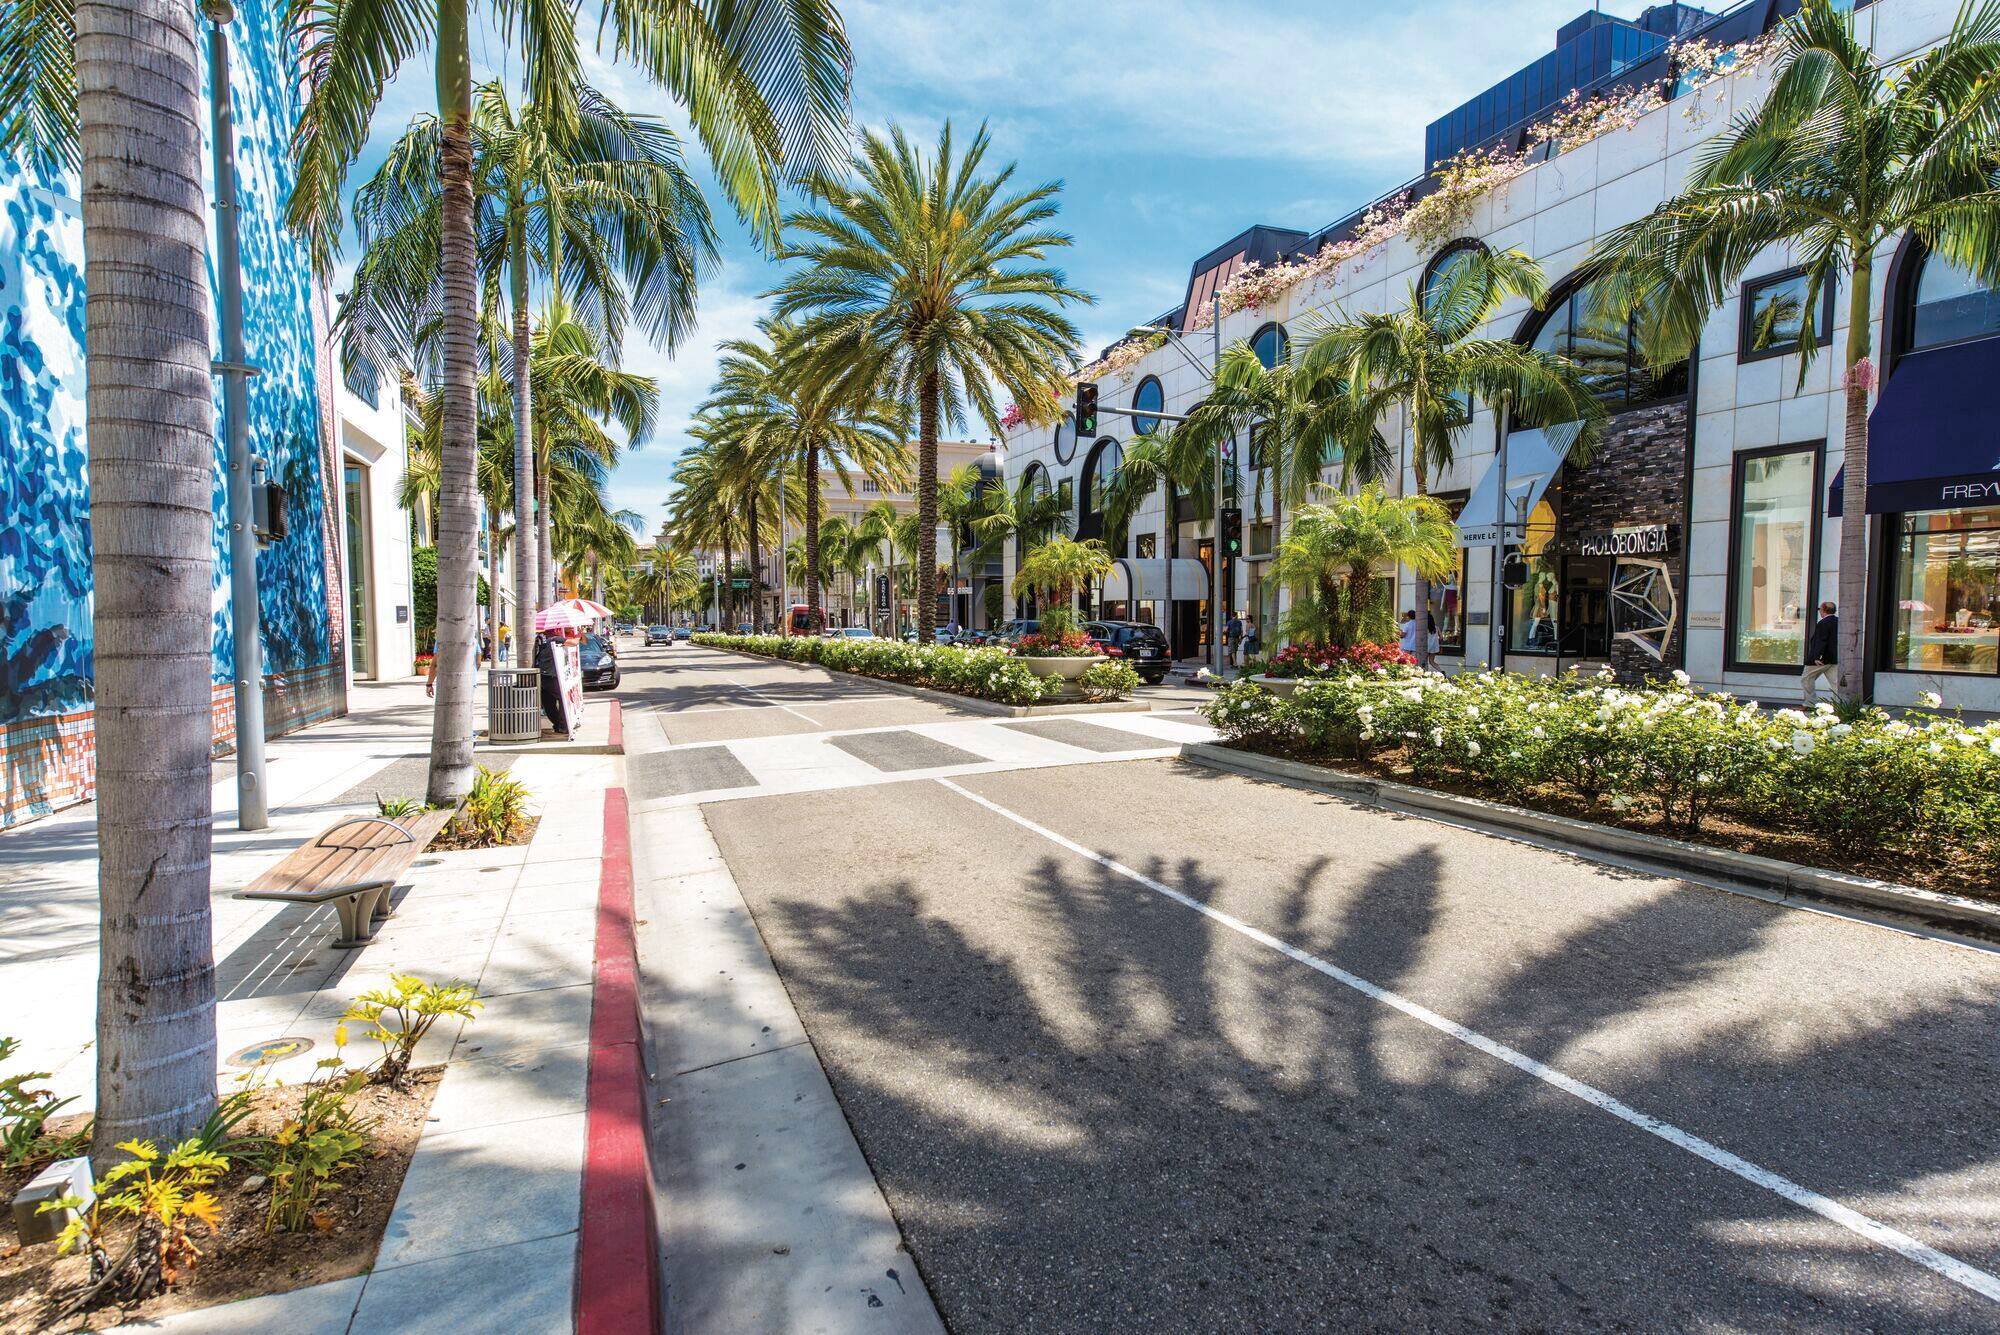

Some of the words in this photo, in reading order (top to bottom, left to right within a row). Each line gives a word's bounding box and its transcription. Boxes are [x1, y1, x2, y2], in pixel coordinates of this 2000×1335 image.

[1463, 533, 1486, 541] HERVE
[1487, 531, 1511, 540] LER
[1582, 529, 1668, 556] PAOLOBONGIA
